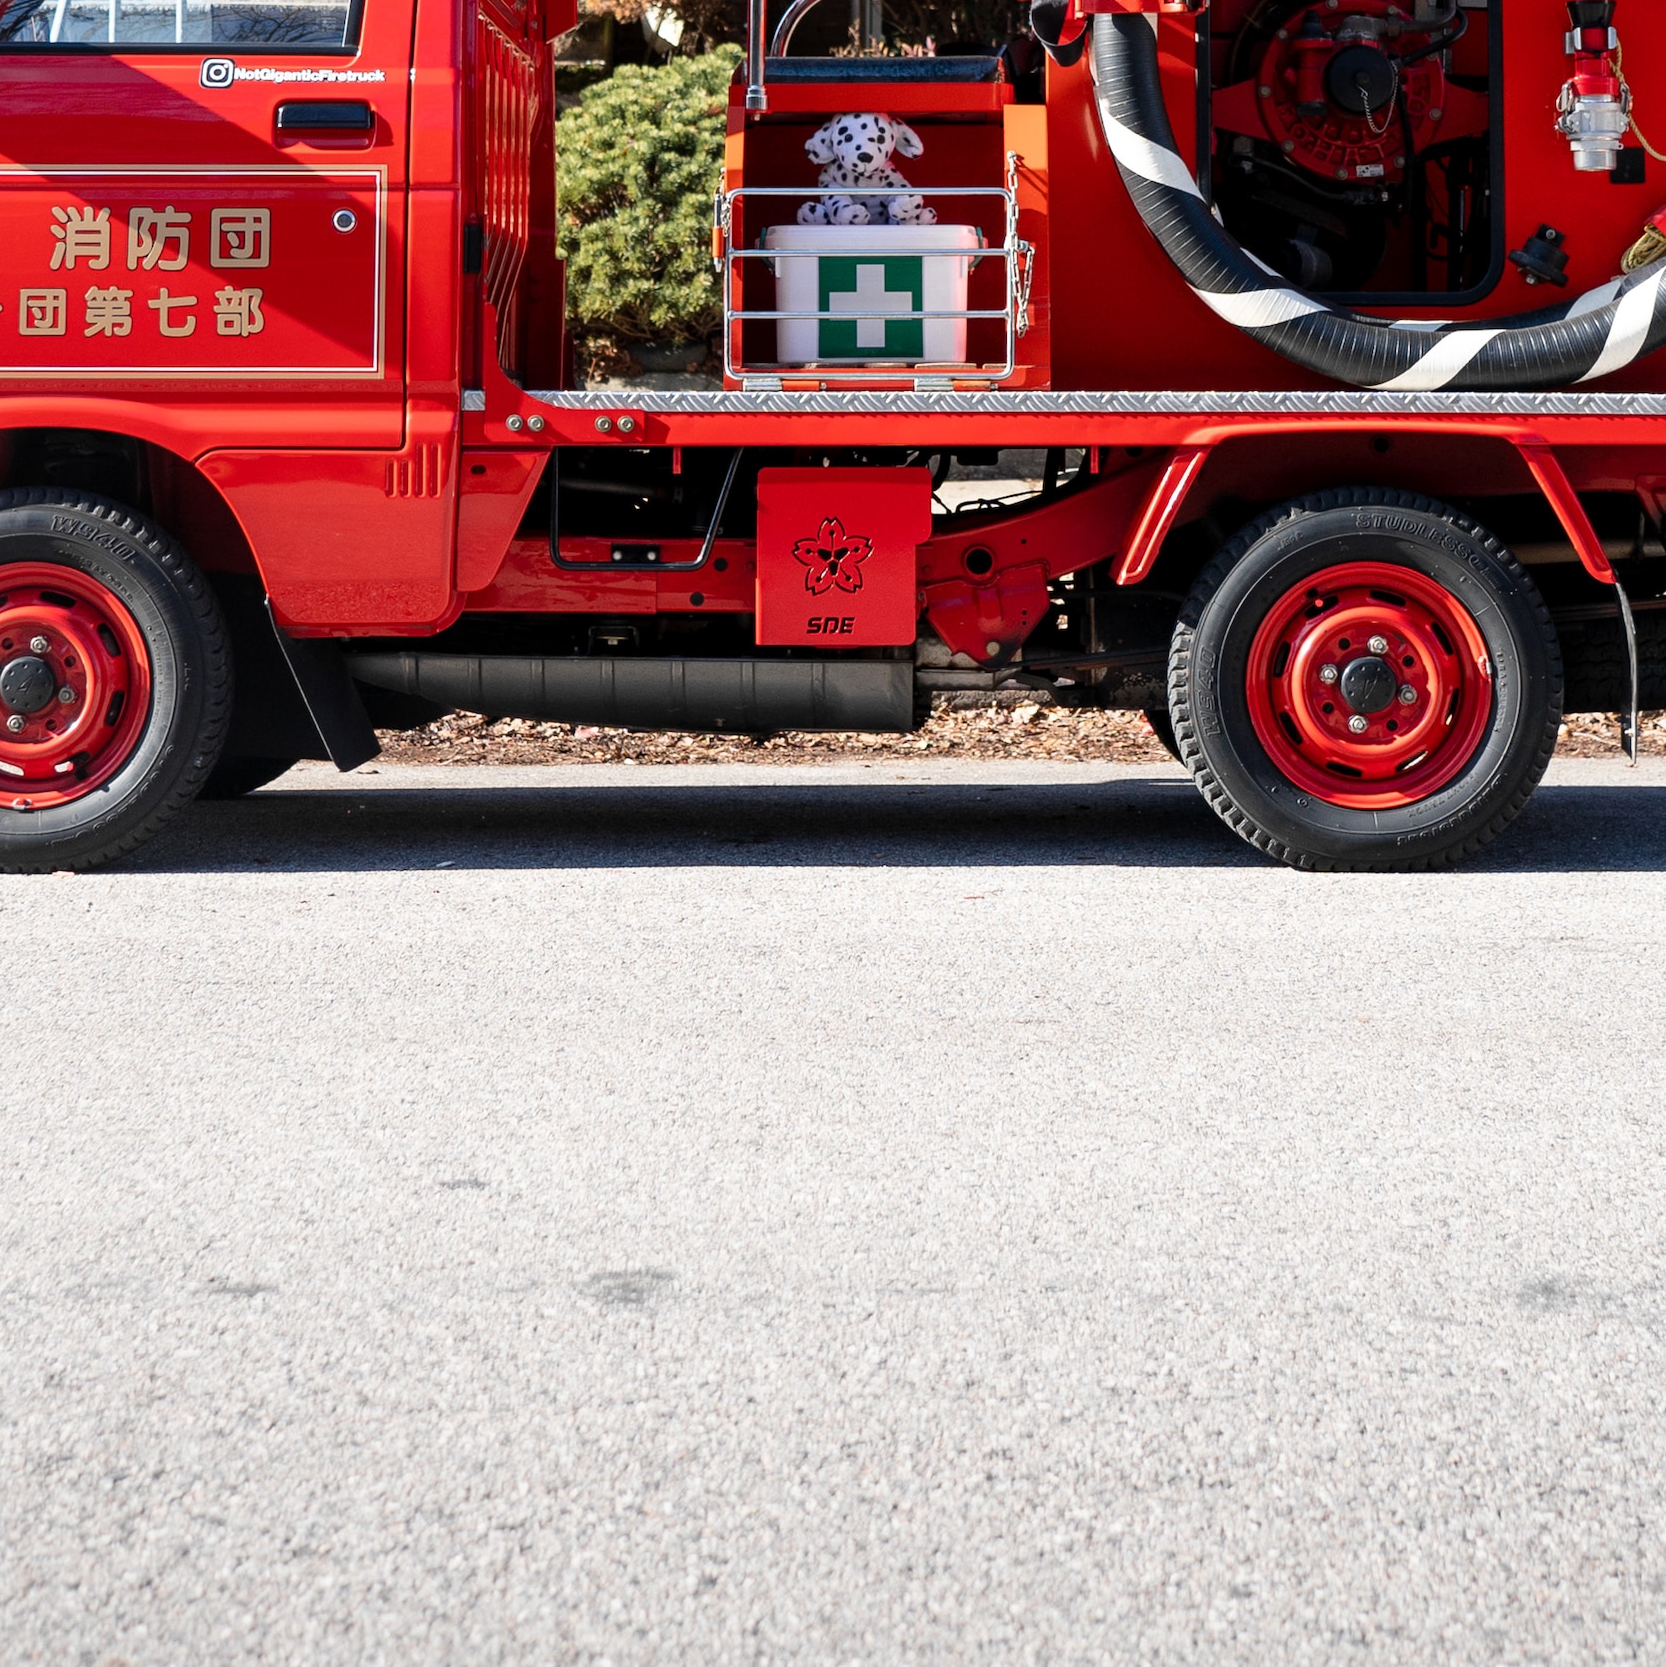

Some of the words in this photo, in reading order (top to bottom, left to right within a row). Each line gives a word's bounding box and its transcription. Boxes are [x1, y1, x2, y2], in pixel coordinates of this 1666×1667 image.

[235, 67, 385, 83] NotGiganticFiretruck
[49, 205, 271, 271] 消防団
